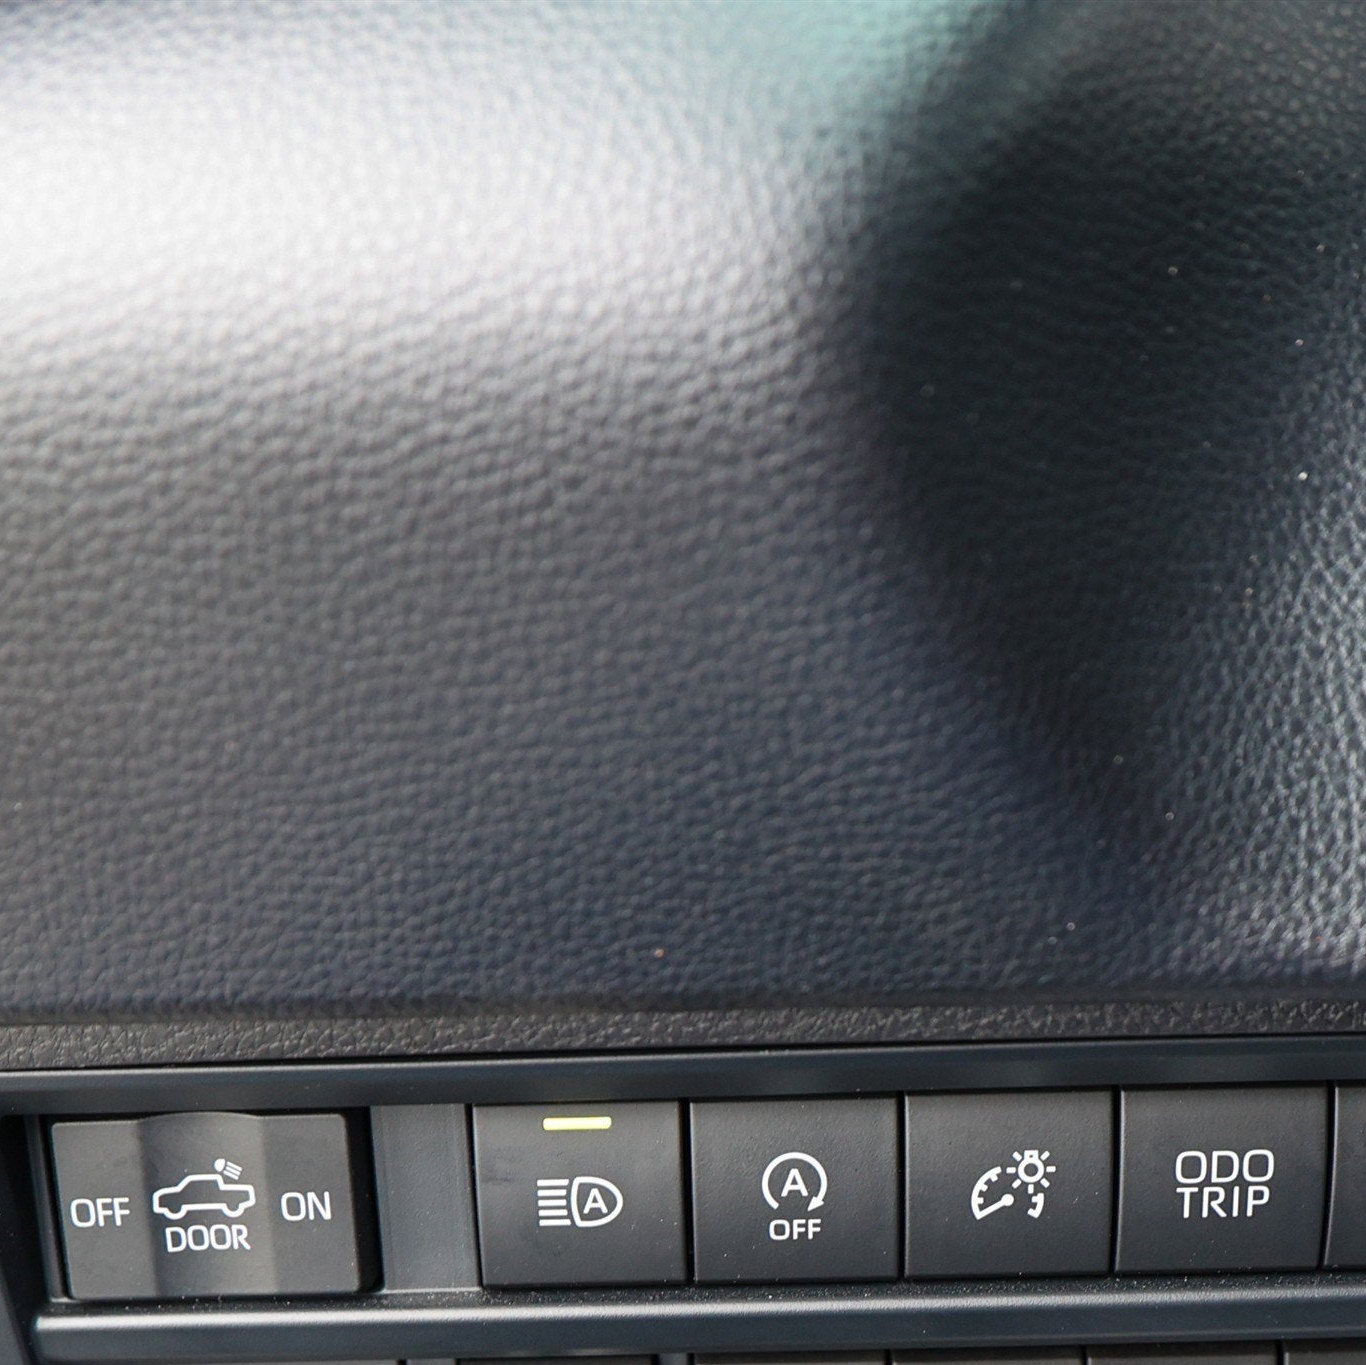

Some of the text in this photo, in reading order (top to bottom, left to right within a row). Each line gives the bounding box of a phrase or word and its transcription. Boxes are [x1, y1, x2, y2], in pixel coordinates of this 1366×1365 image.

[1174, 1149, 1275, 1184] ODO
[780, 1168, 809, 1197] A
[70, 1197, 131, 1228] OFF
[280, 1191, 332, 1222] ON
[582, 1187, 609, 1214] A
[1176, 1185, 1270, 1218] TRIP
[165, 1223, 252, 1253] DOOR
[768, 1218, 822, 1241] OFF
